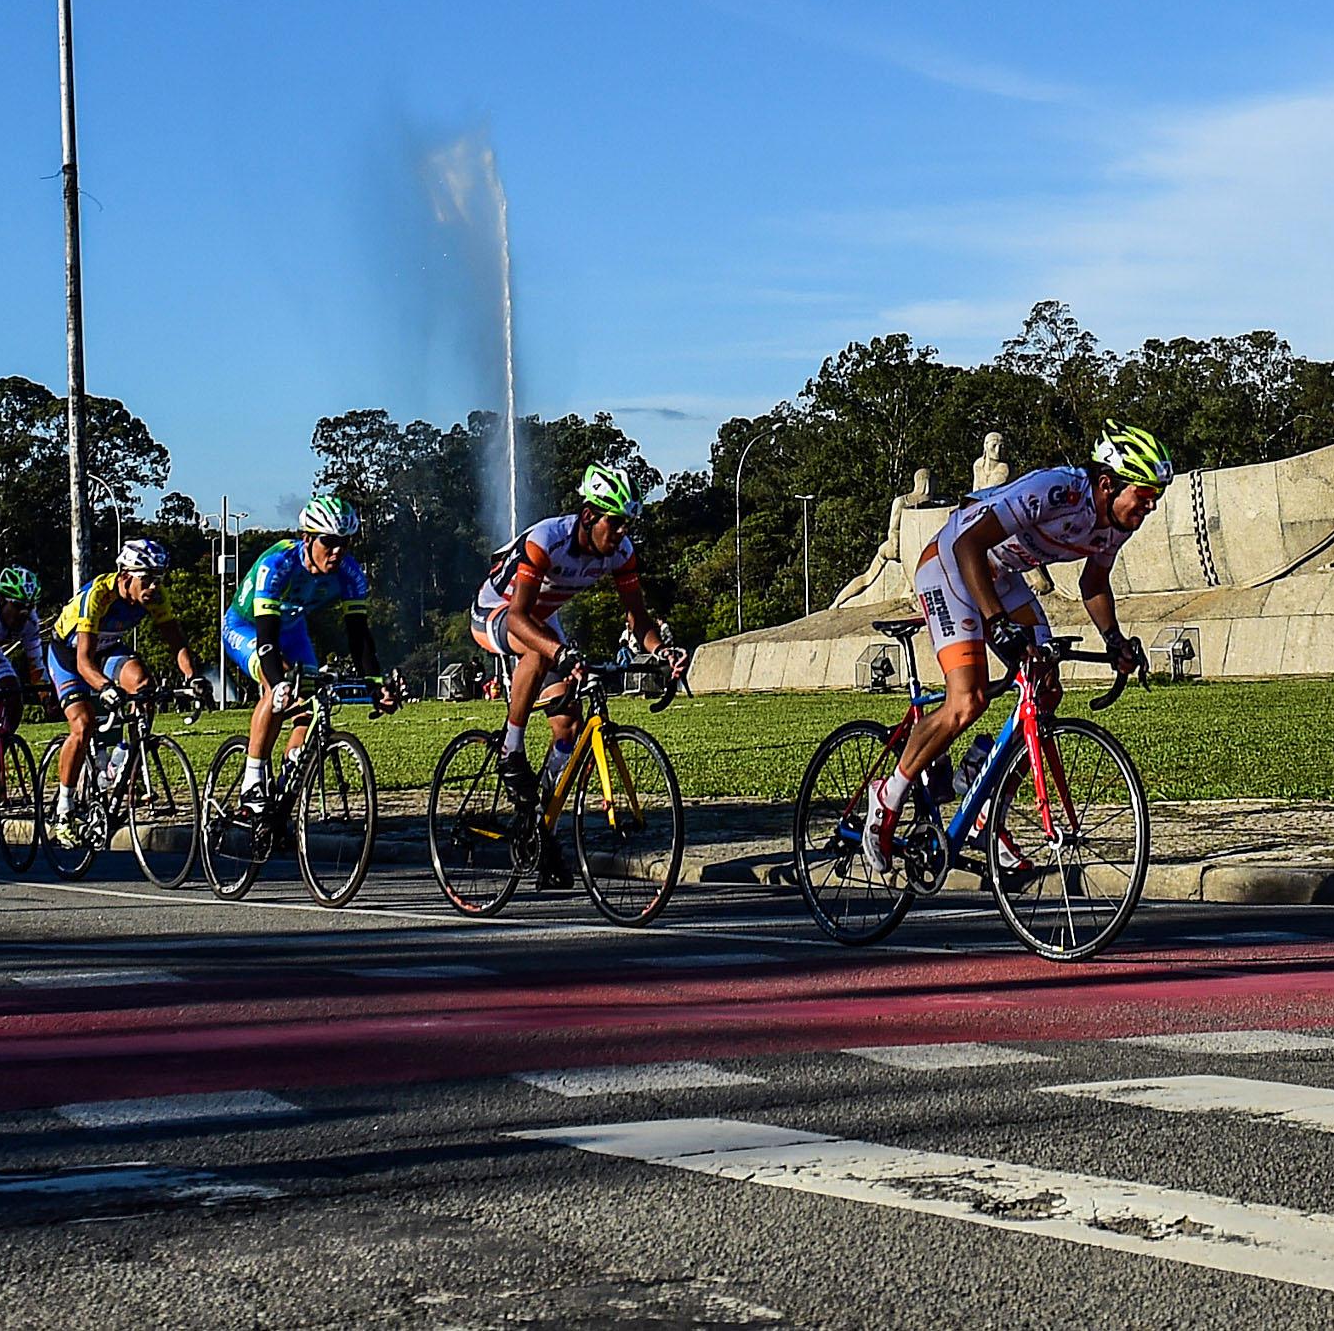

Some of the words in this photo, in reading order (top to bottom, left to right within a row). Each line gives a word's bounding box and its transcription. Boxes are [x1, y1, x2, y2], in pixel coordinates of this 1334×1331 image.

[1103, 447, 1114, 463] 2
[592, 482, 602, 491] 4
[960, 741, 1003, 815] SOUL
